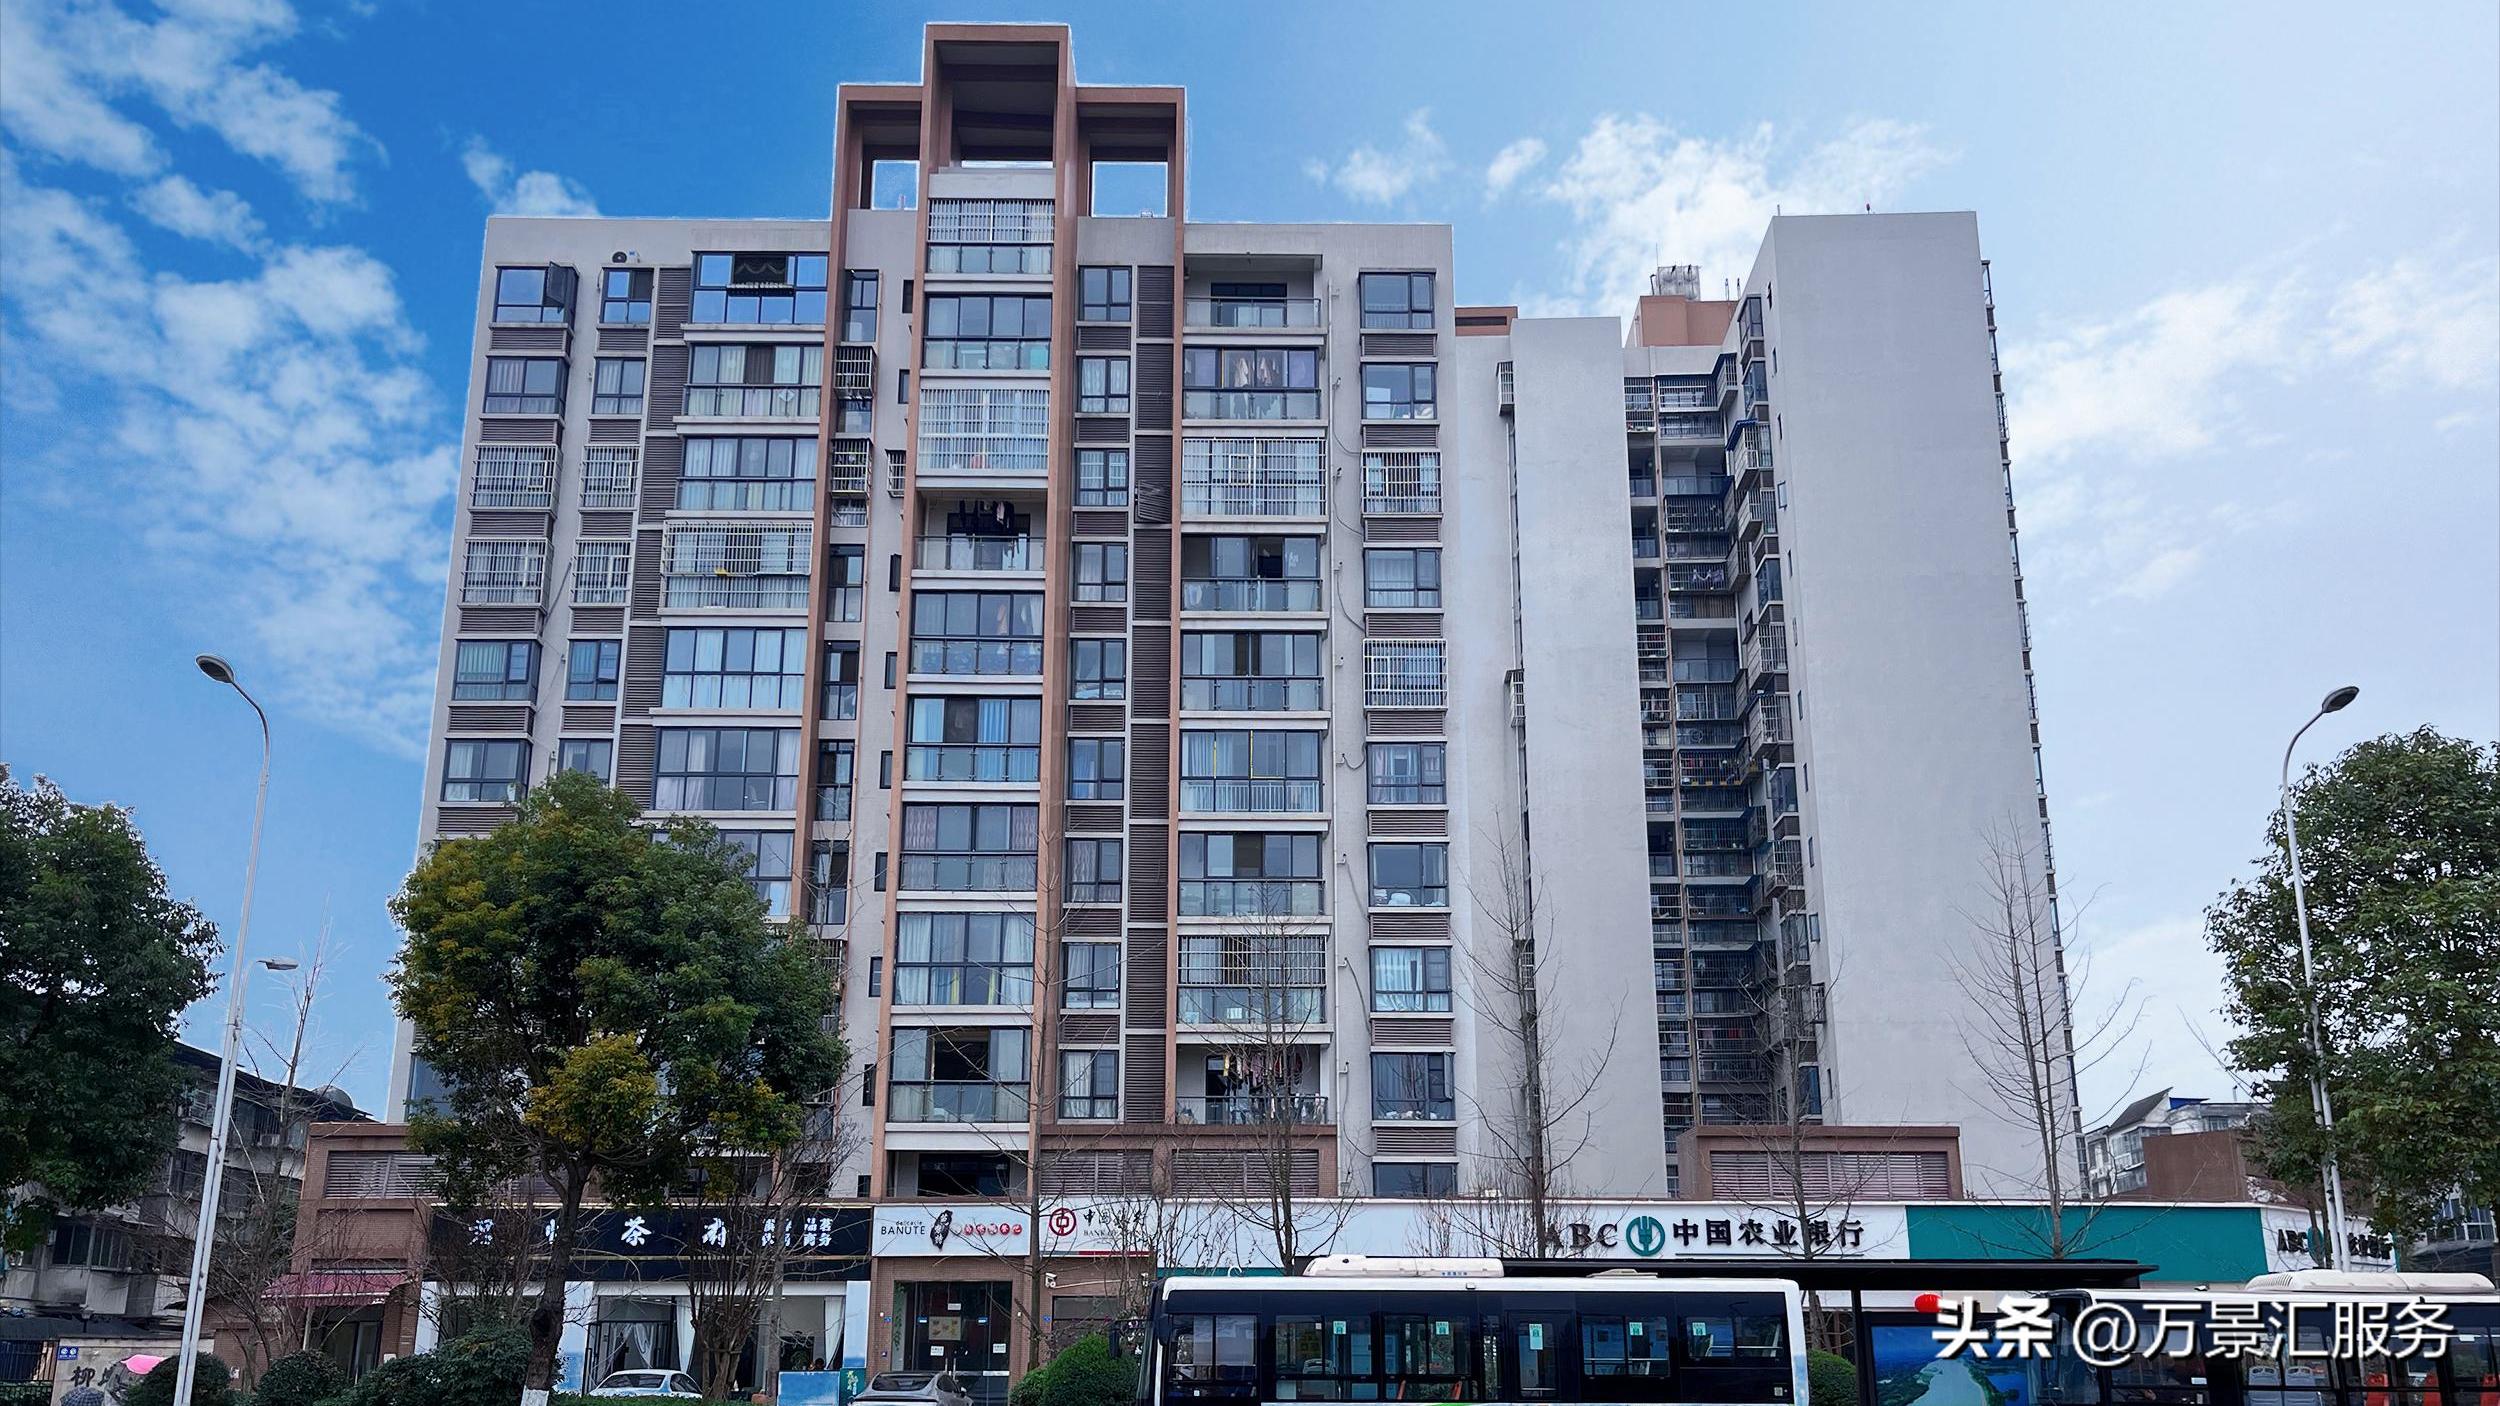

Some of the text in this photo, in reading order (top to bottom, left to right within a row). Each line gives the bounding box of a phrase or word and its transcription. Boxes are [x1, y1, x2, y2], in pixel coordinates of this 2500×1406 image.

[881, 1225, 925, 1235] BANUTE
[1545, 1223, 1618, 1248] ABC
[1673, 1218, 1864, 1247] 中国农业银行
